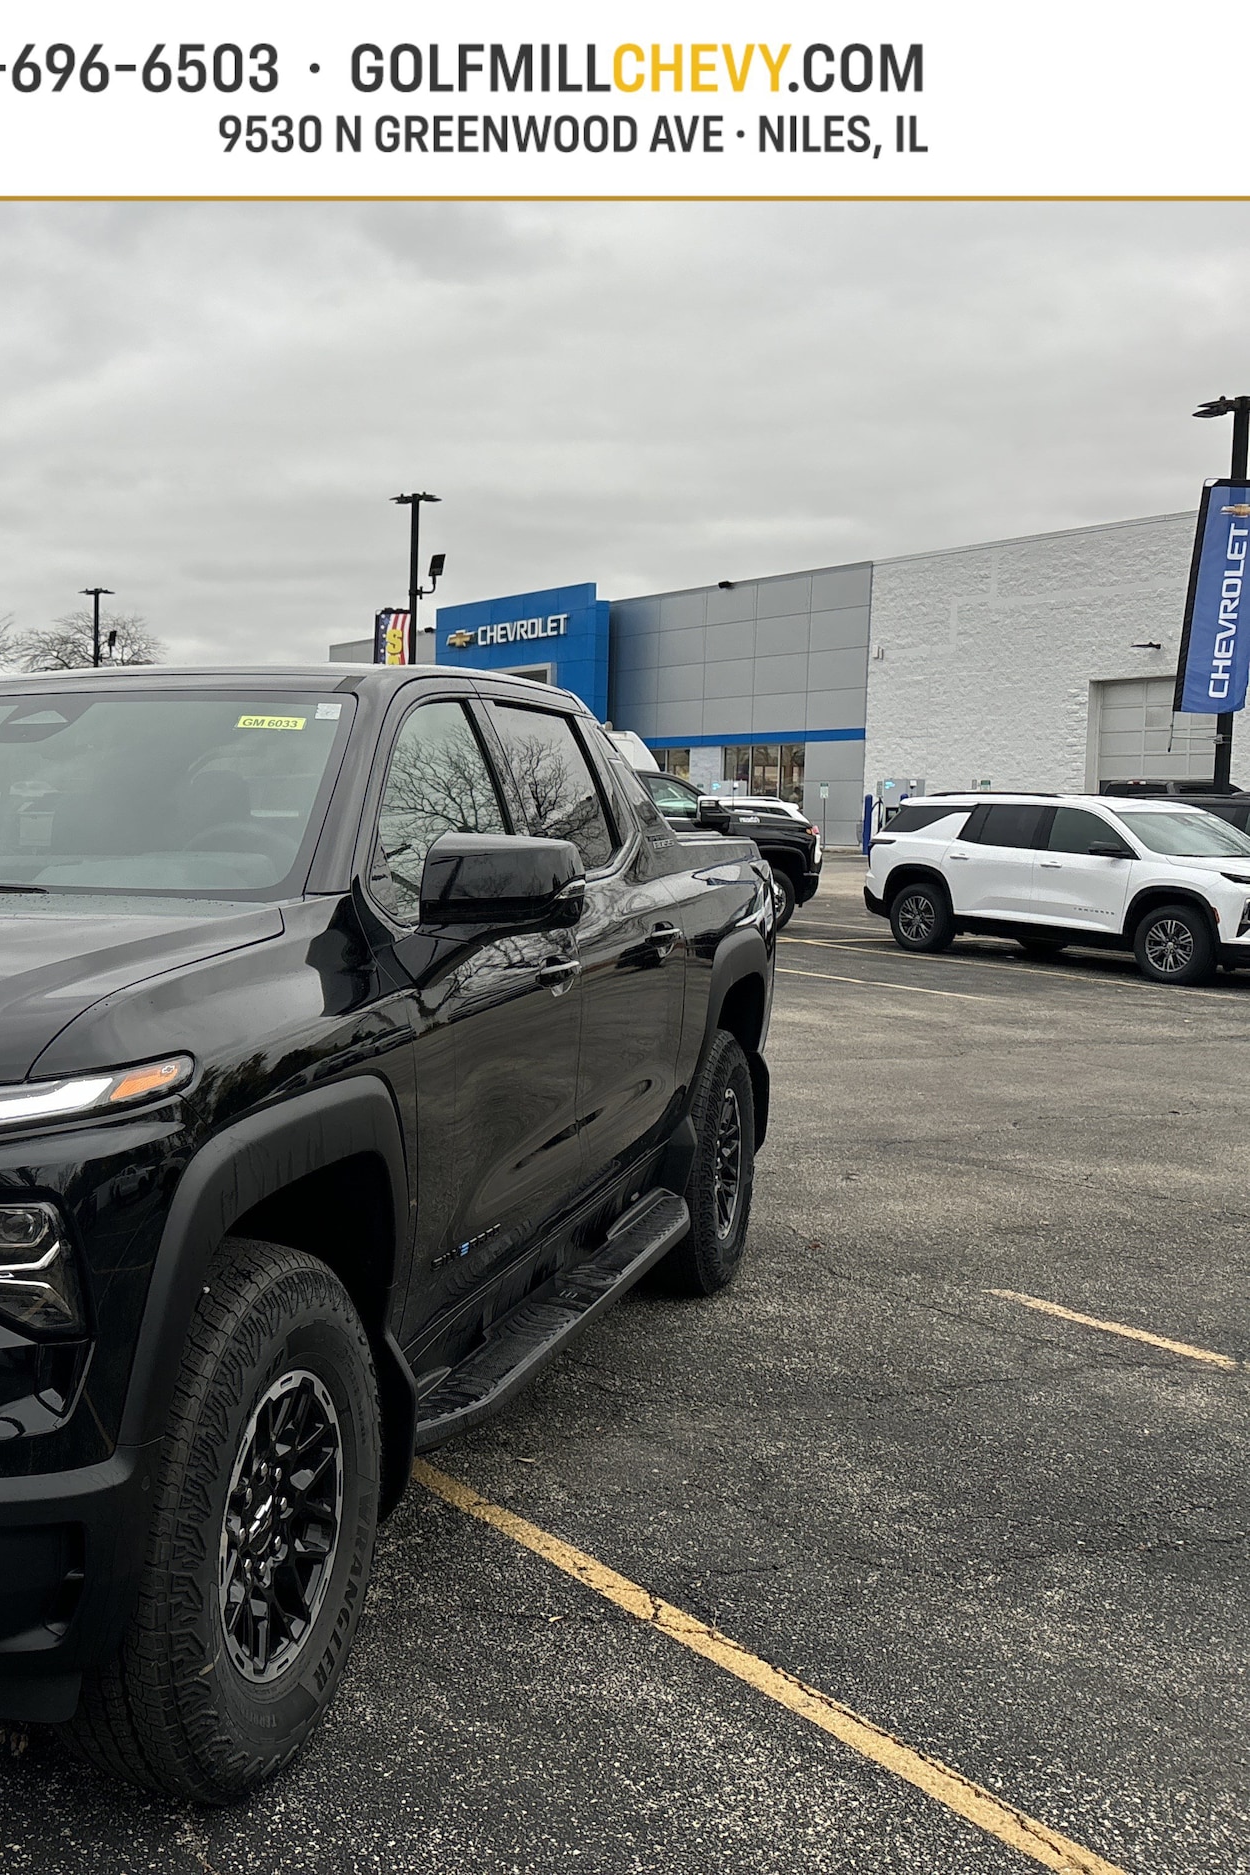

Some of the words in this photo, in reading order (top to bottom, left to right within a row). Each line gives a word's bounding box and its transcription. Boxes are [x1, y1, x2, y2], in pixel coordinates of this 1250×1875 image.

[477, 613, 569, 646] CHEVROLET
[1208, 522, 1249, 699] CHEVROLET
[242, 718, 265, 727] GM
[267, 719, 299, 728] 6033
[313, 1492, 374, 1693] WRANGLER
